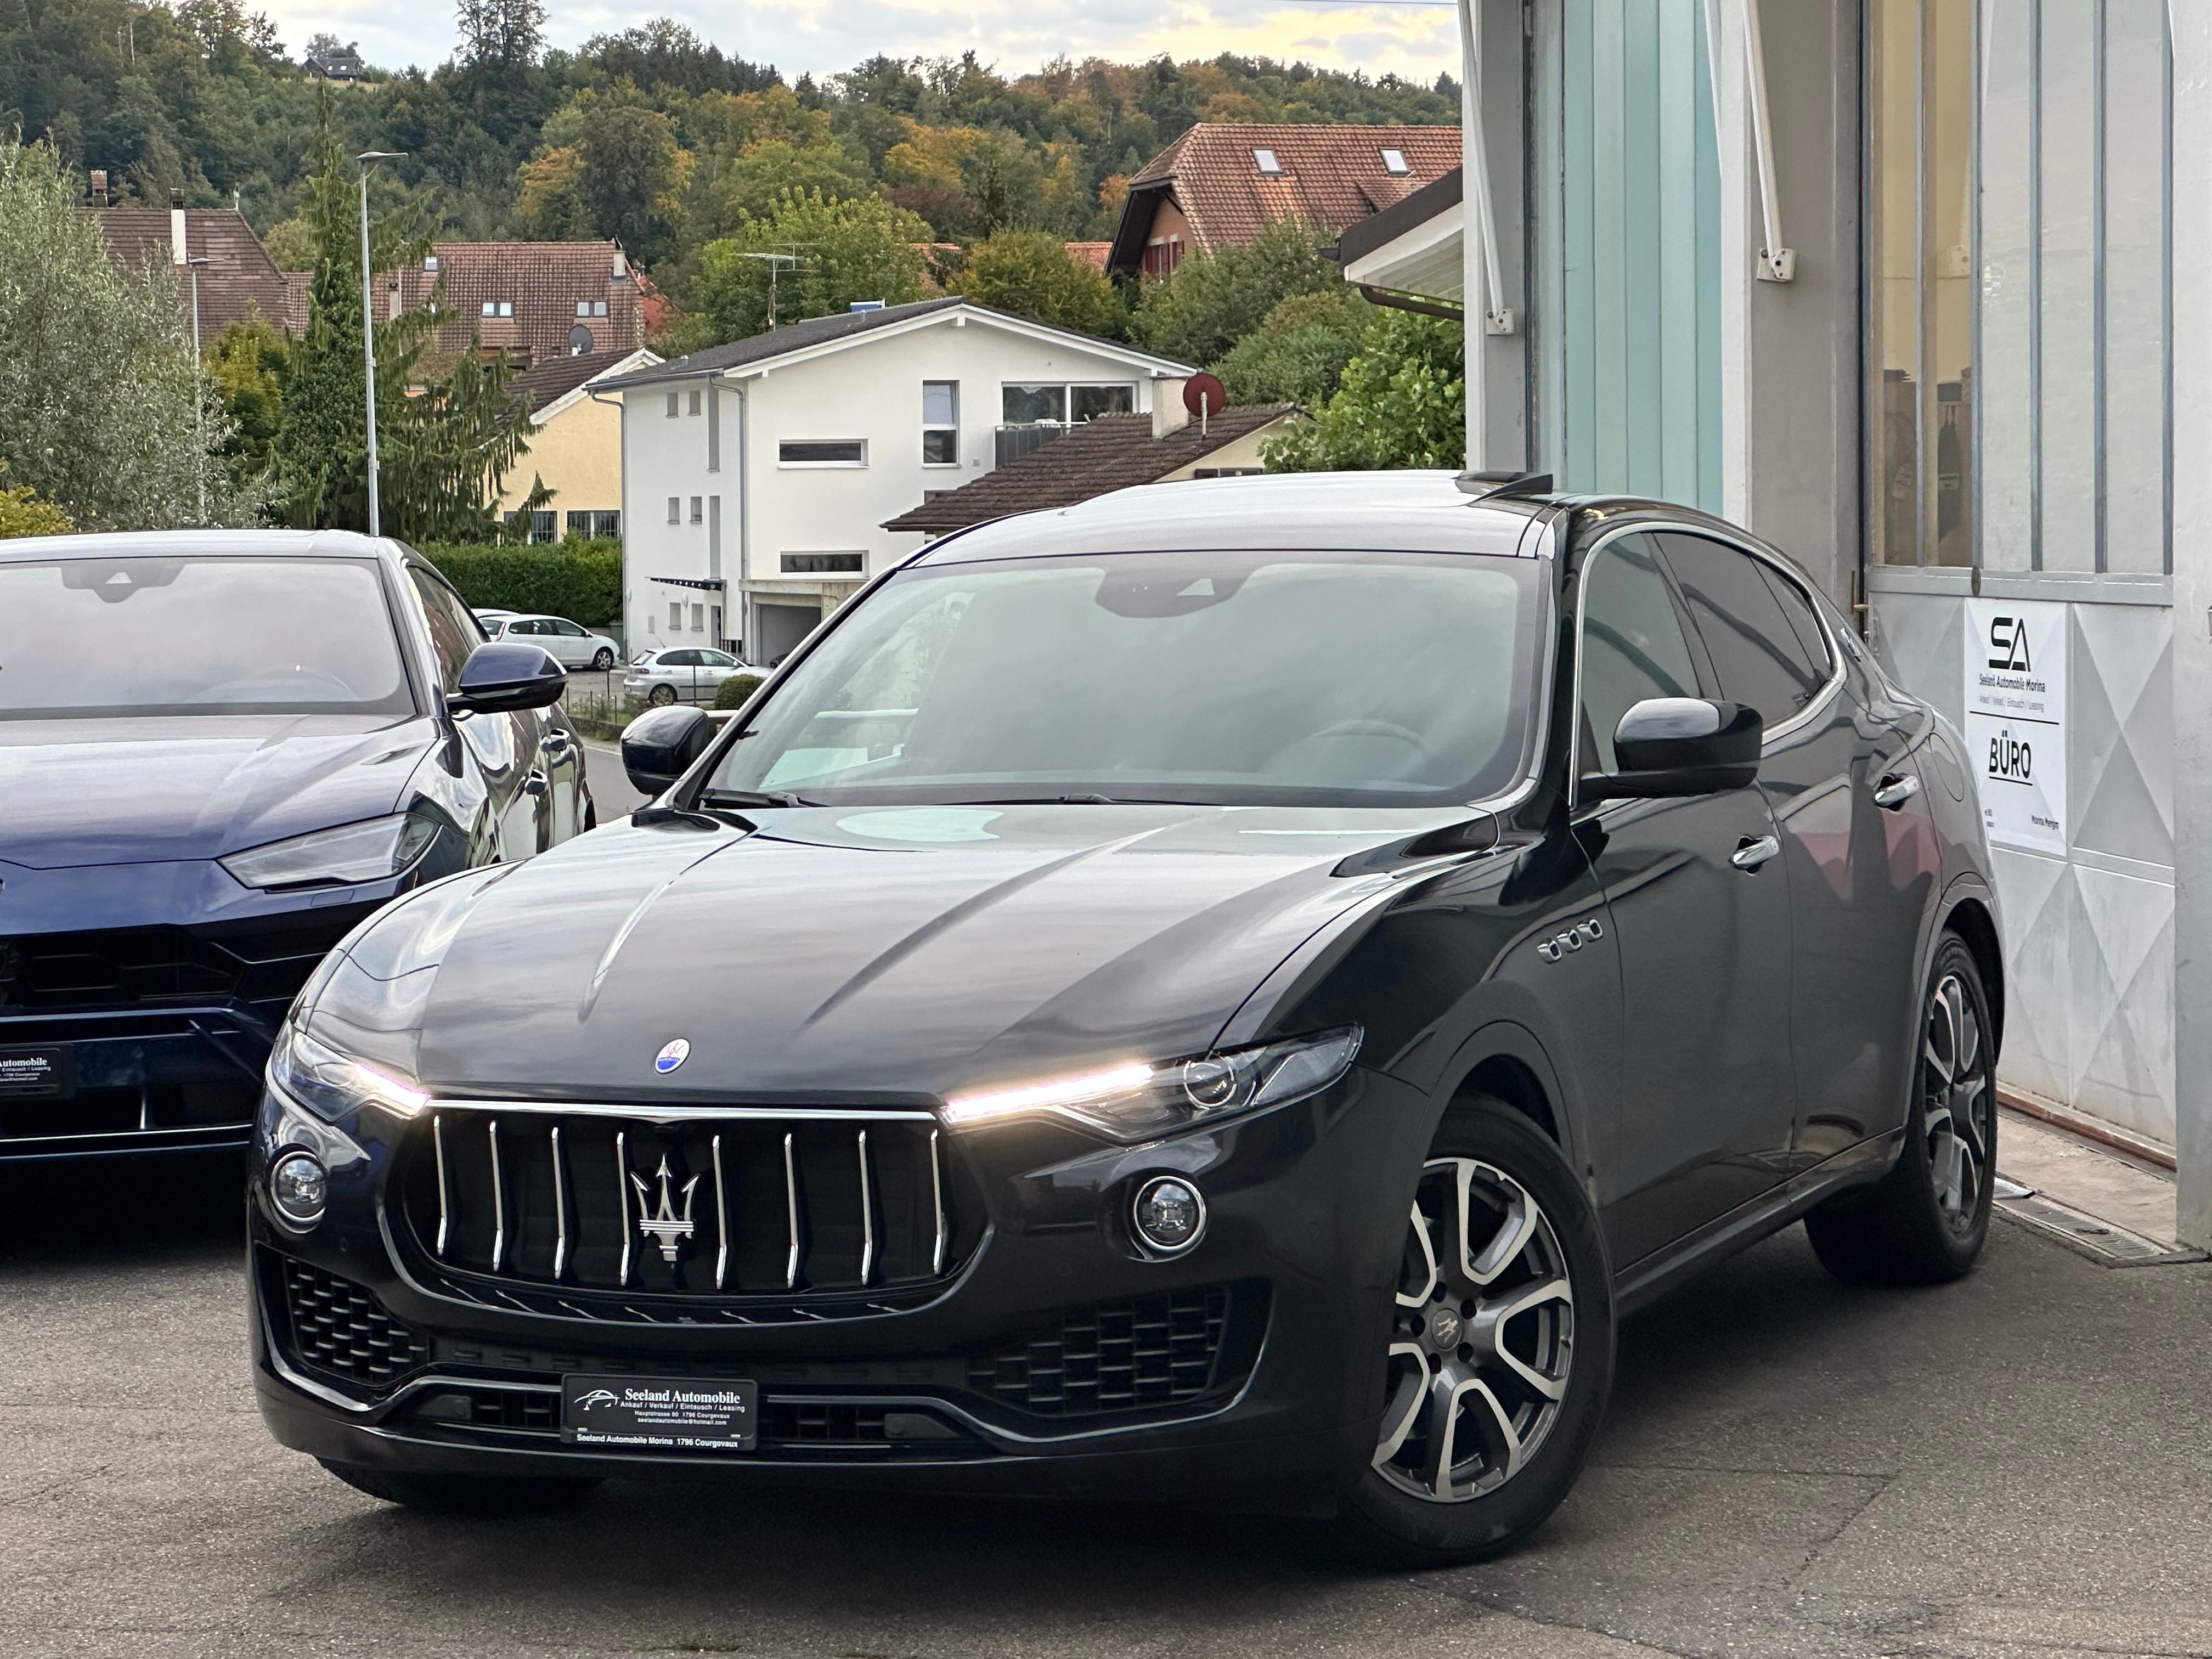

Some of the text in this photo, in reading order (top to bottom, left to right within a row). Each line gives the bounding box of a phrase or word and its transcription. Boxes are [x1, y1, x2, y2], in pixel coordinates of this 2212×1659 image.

[1989, 617, 2031, 672] SA
[1979, 673, 2045, 692] Seeland Automobile Morina
[1989, 730, 2032, 779] BÜRO
[625, 1389, 740, 1404] Seeland Automobile
[719, 1404, 745, 1413] Leasing
[577, 1434, 738, 1448] Seeland Automobile Morina 1796 Courgevaux
